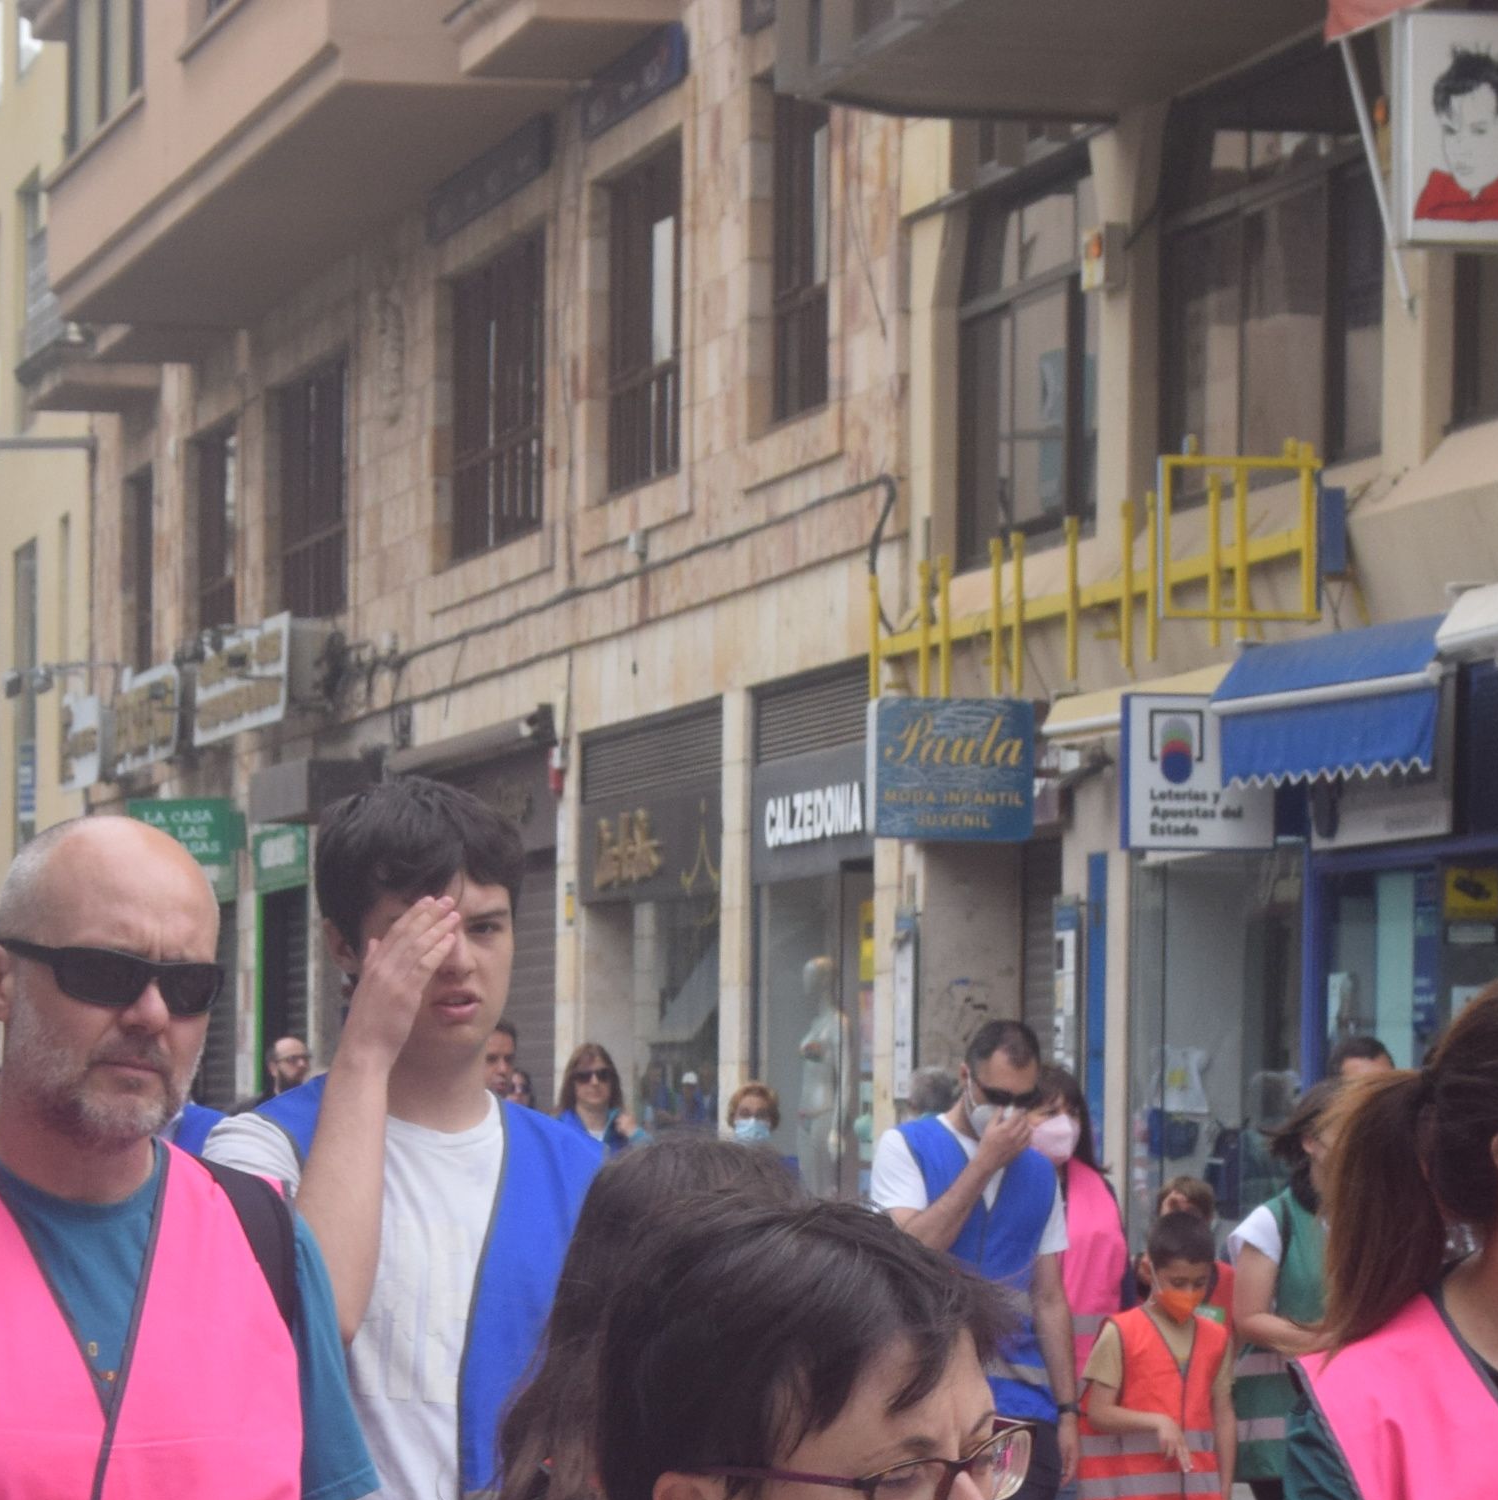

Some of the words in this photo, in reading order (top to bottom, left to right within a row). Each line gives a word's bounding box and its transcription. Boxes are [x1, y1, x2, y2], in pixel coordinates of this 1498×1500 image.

[885, 712, 1024, 767] Paula
[883, 790, 936, 805] MODA
[945, 790, 1024, 807] INFANTIL
[1212, 790, 1220, 805] y
[171, 810, 213, 823] CASA
[764, 781, 863, 848] CALZEDONIA
[1151, 803, 1216, 821] Apuestas
[1221, 805, 1242, 819] del
[178, 826, 207, 839] LAS
[1150, 821, 1199, 837] Estado
